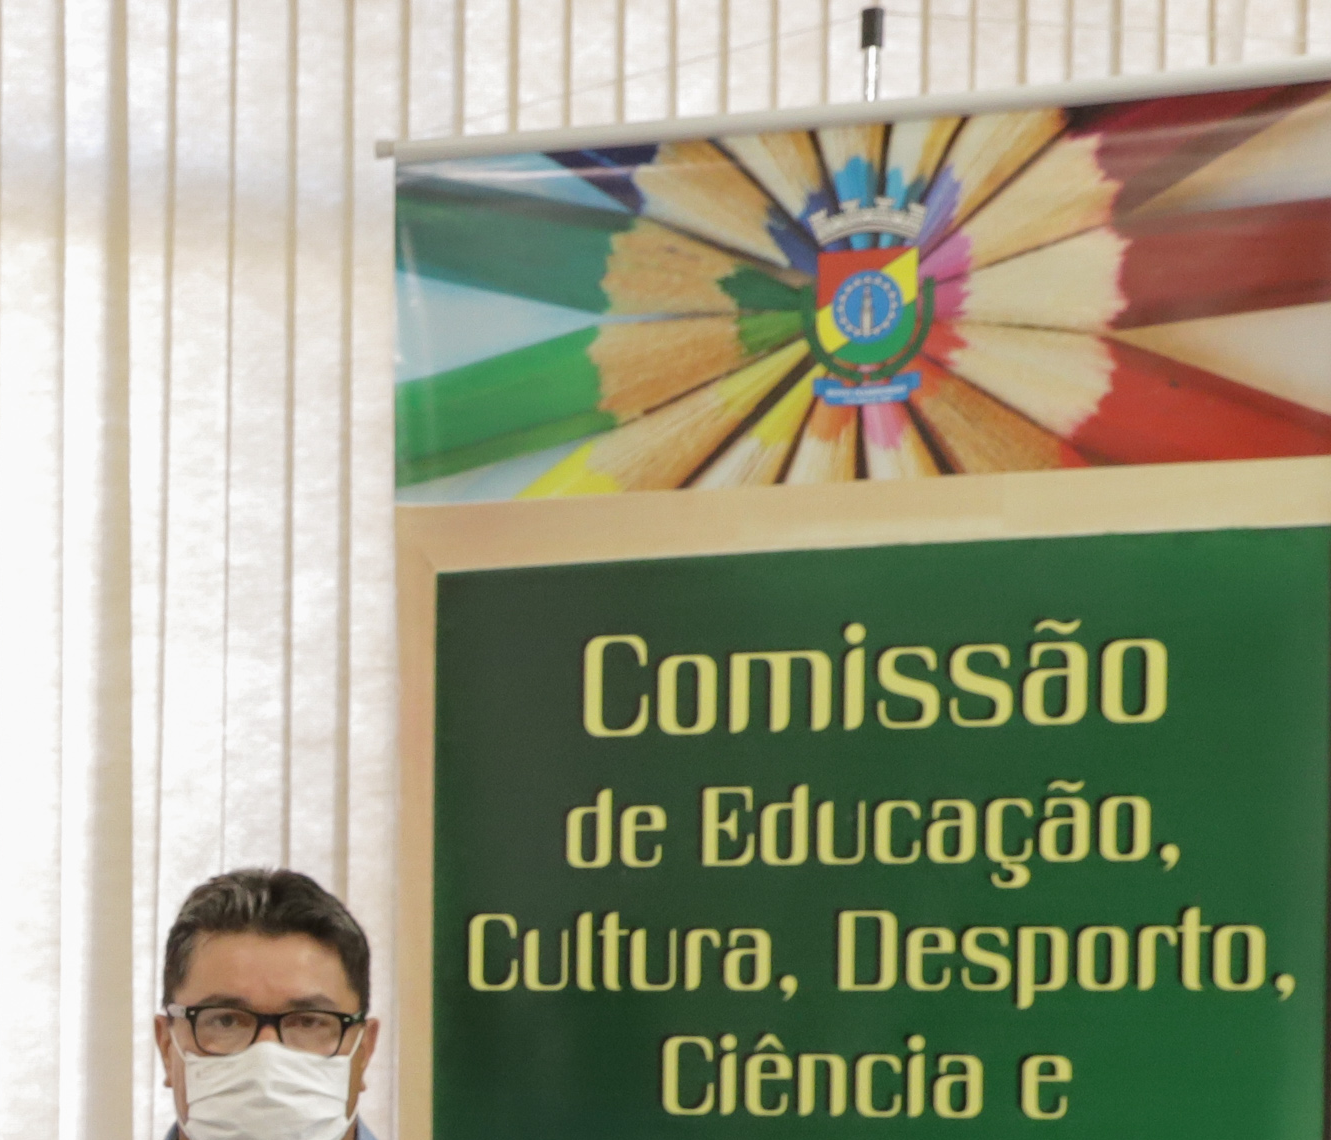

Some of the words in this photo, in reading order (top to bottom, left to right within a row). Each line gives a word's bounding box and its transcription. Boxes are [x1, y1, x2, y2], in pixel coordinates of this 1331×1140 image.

[582, 618, 1169, 738] Comissão
[565, 787, 668, 869] de
[701, 779, 1181, 889] Educação,
[467, 911, 799, 999] Cultura,
[837, 906, 1296, 1010] Desporto,
[661, 1033, 984, 1119] Ciência
[1021, 1054, 1074, 1119] e
